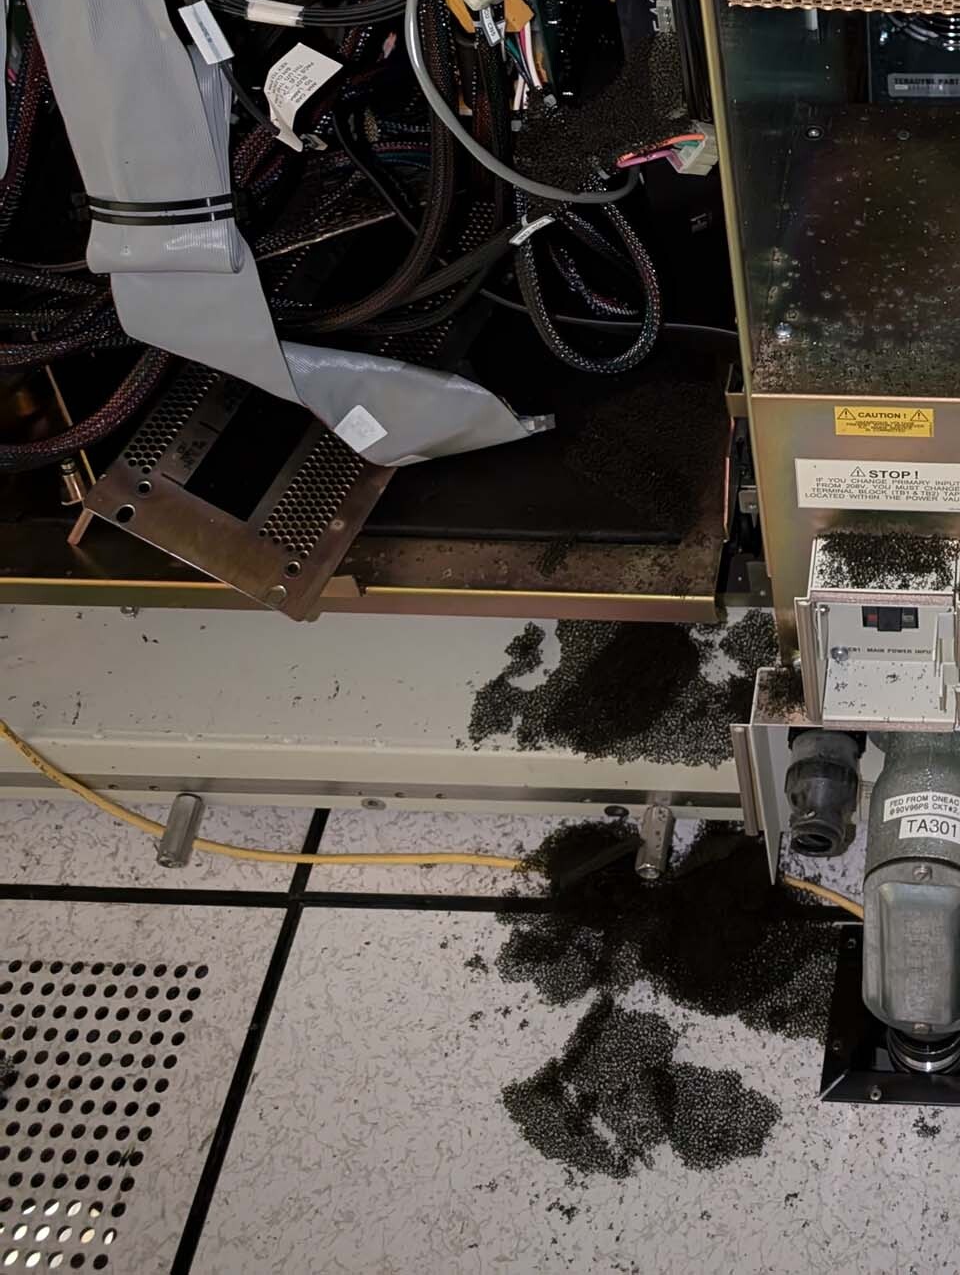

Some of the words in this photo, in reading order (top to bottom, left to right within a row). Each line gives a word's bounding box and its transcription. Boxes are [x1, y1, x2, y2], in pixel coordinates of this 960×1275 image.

[868, 470, 911, 479] STOP
[890, 799, 904, 808] FED
[906, 795, 929, 803] FROM
[907, 819, 957, 838] TA301
